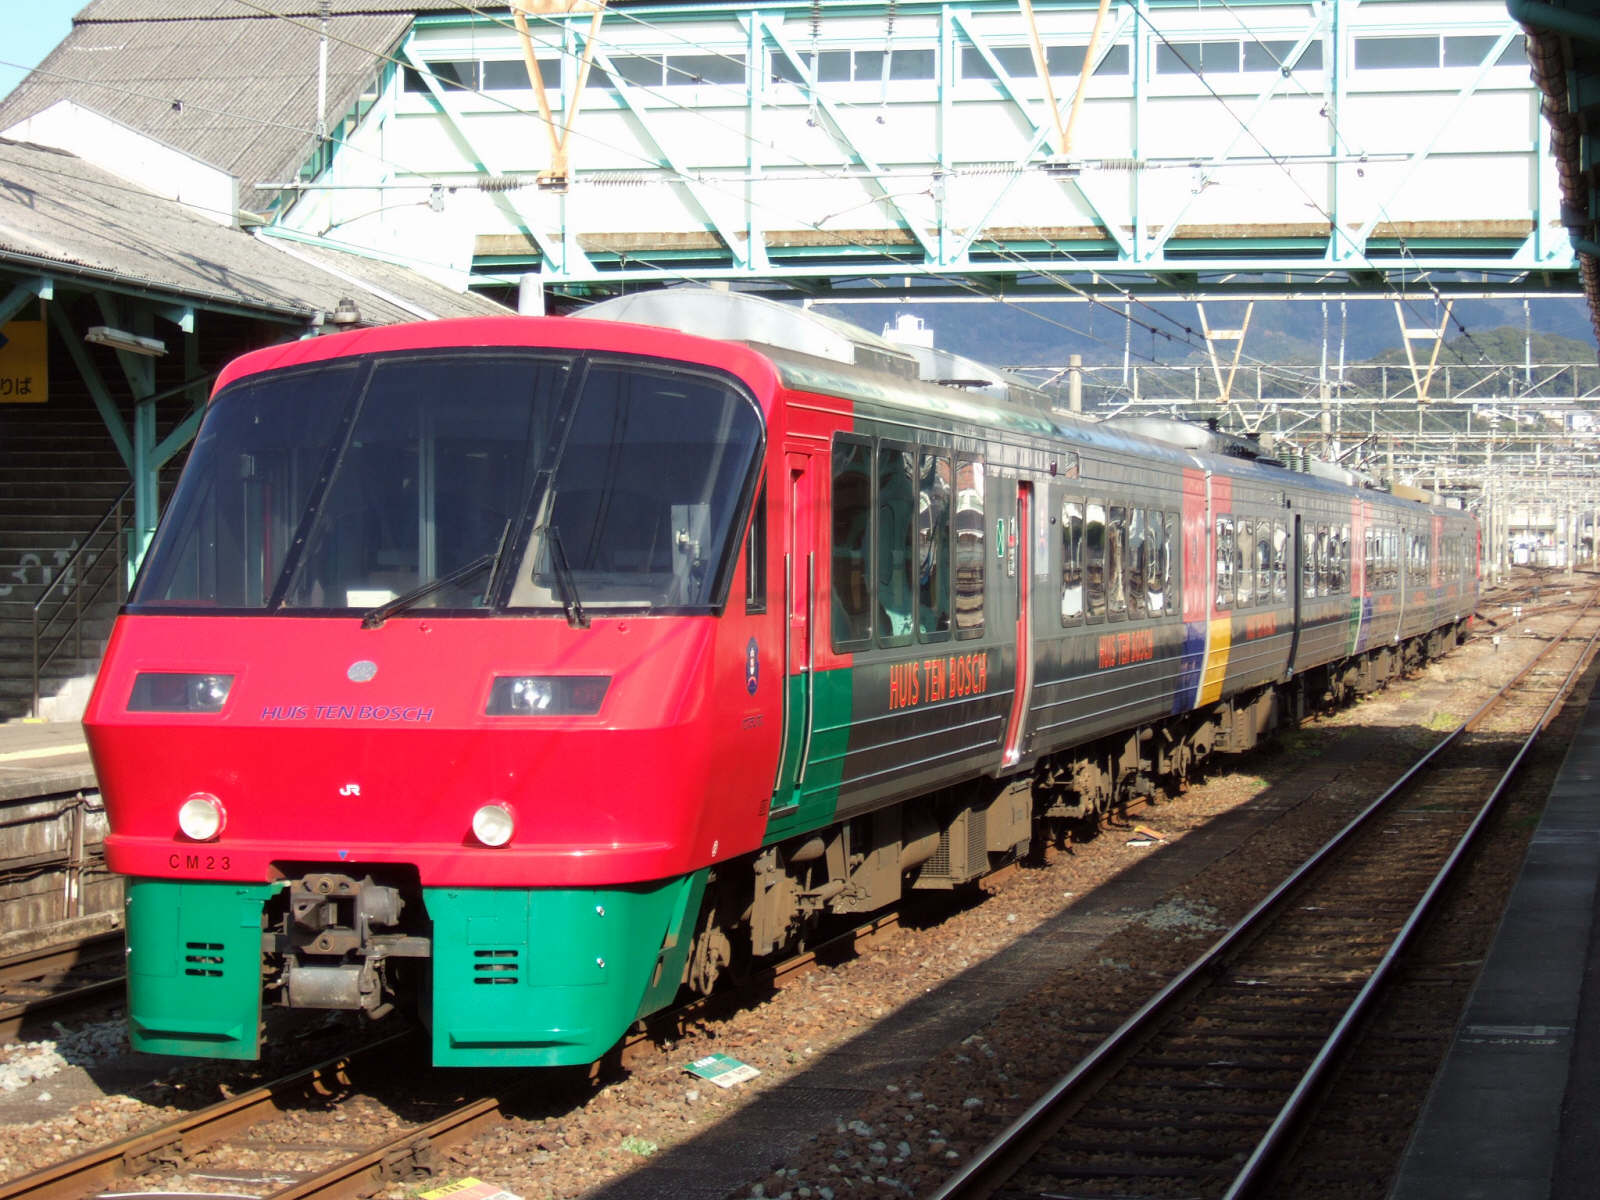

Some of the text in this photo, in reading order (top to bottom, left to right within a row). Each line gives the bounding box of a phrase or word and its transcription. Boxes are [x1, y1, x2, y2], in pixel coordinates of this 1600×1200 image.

[889, 653, 987, 710] HUIS TEN BOSCH
[261, 705, 434, 722] HUIS TEN BOSCH
[339, 784, 361, 796] JR
